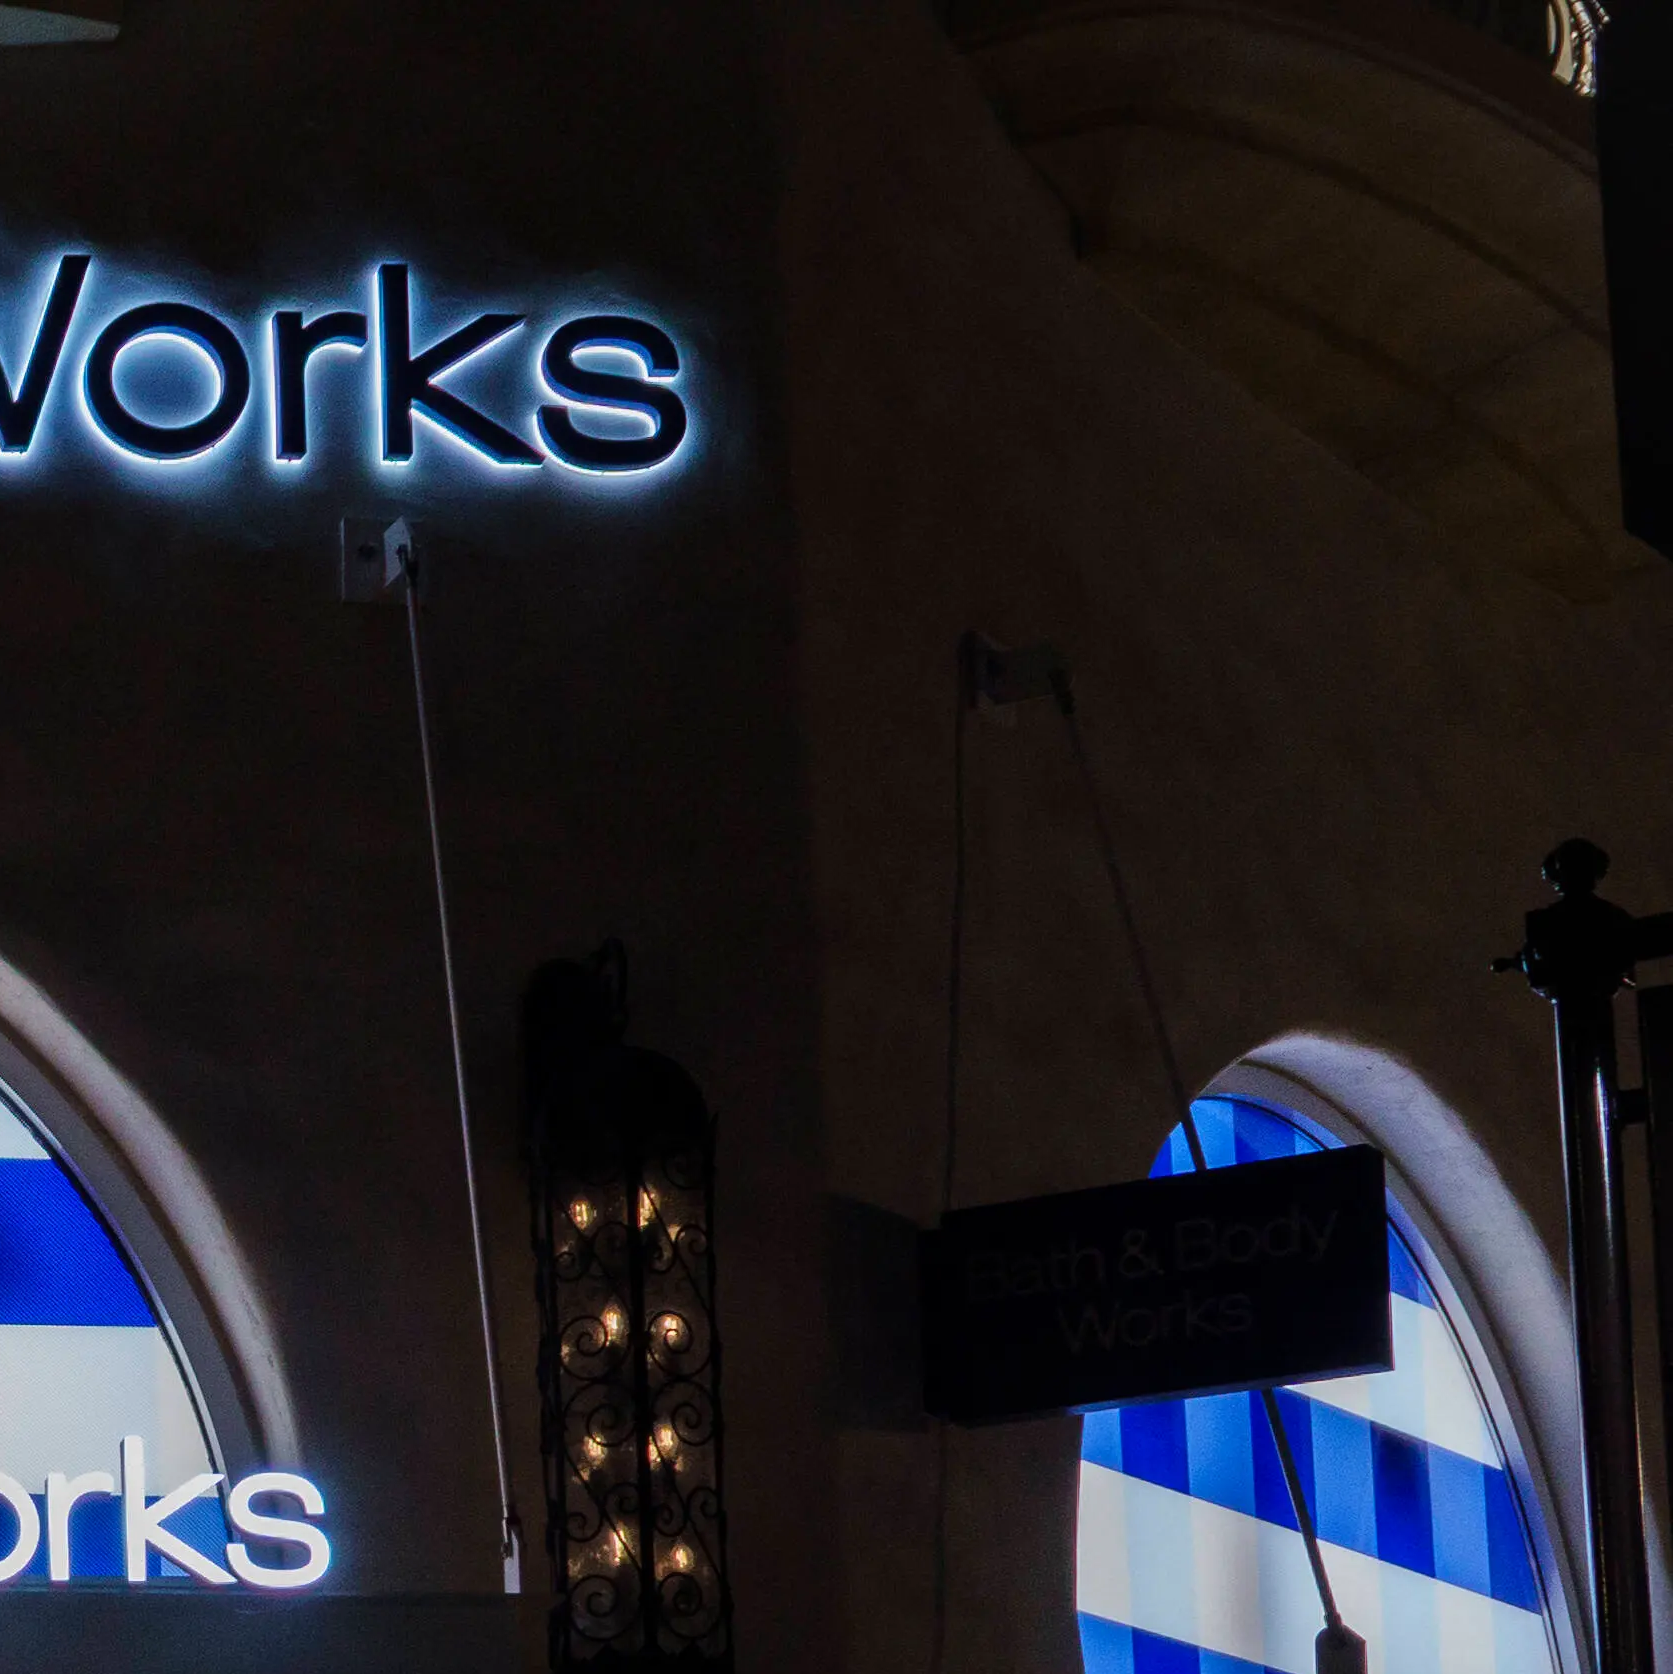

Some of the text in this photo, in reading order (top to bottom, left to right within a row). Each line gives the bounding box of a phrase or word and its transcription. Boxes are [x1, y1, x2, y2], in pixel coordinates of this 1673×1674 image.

[965, 1205, 1339, 1304] Bath & Body
[1057, 1291, 1255, 1356] Works
